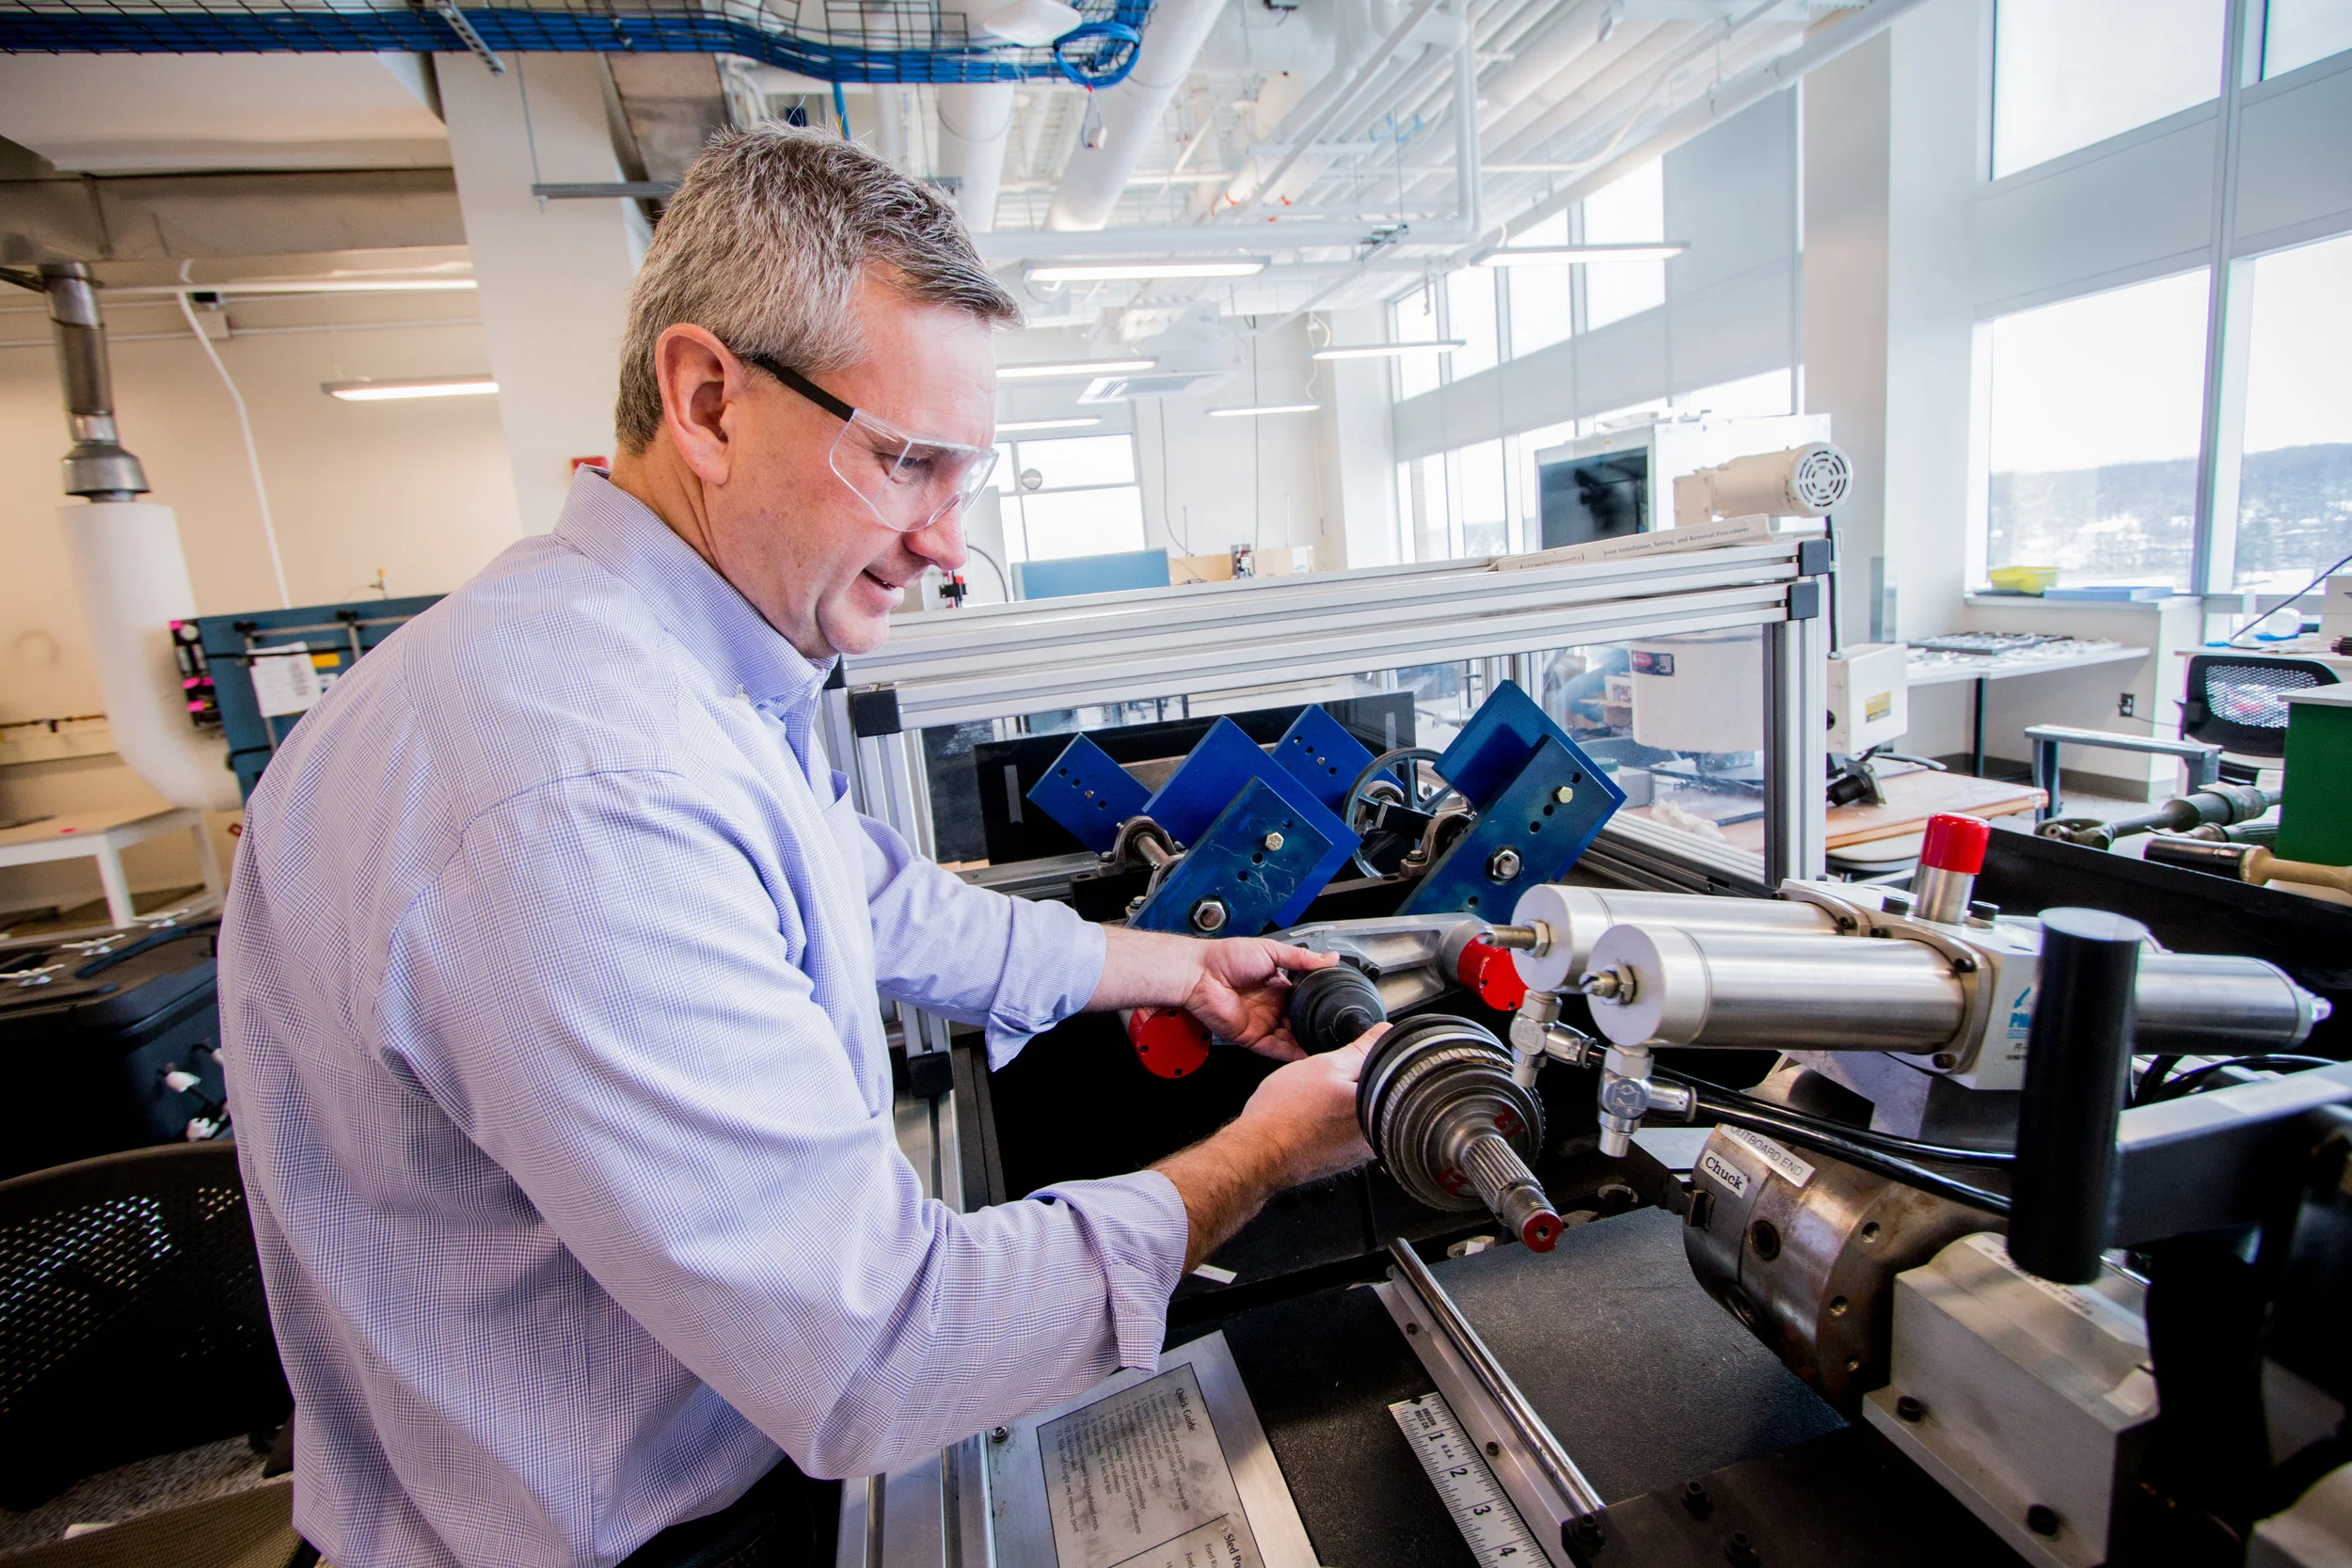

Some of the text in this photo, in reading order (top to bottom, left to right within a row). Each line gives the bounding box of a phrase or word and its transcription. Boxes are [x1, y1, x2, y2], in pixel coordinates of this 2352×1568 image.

[1690, 531, 1714, 541] Removal
[1716, 527, 1750, 537] Procedures
[1706, 1156, 1743, 1190] Chuck
[1780, 1157, 1804, 1177] END
[1175, 1388, 1196, 1431] Quick Guide
[1422, 1407, 1438, 1427] OREGON
[1414, 1410, 1430, 1431] RULE CO.
[1428, 1433, 1445, 1442] 1
[1450, 1467, 1468, 1478] 2
[1473, 1505, 1491, 1515] 3
[1205, 1543, 1216, 1560] Ford
[1224, 1533, 1239, 1555] Sled
[1499, 1547, 1518, 1557] 4
[1185, 1551, 1196, 1568] Ford
